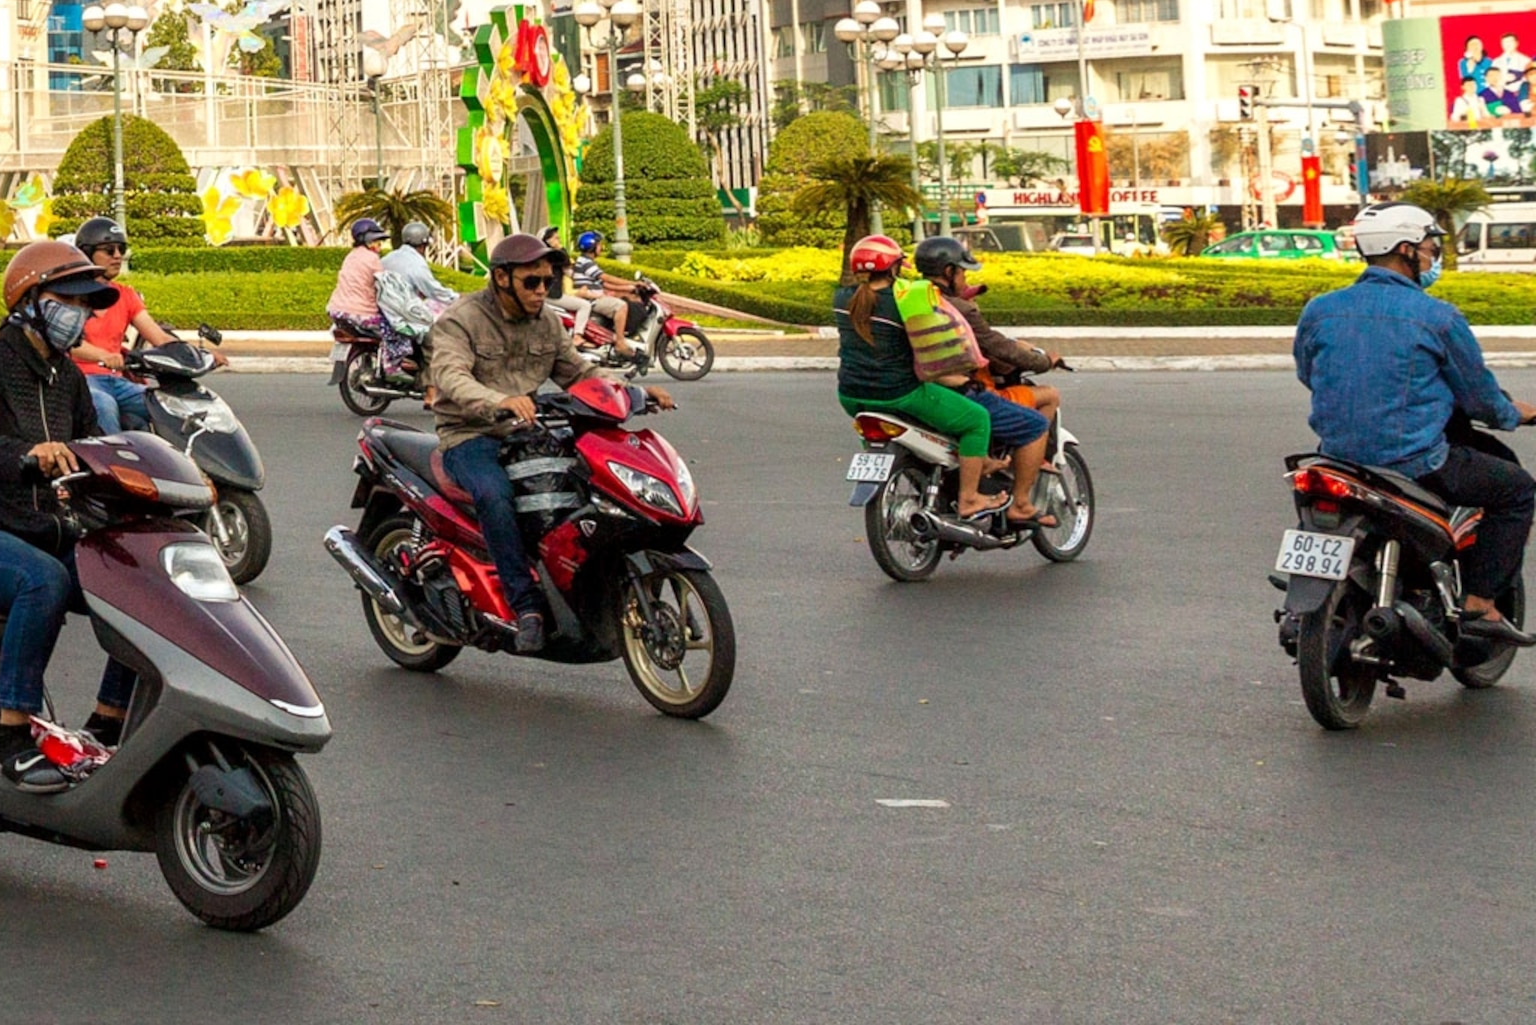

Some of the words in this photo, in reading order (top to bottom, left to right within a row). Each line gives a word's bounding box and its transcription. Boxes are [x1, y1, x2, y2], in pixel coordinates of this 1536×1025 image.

[1111, 189, 1160, 204] OFFEE
[1293, 535, 1342, 557] 60-C2
[1281, 552, 1343, 576] 298.94
